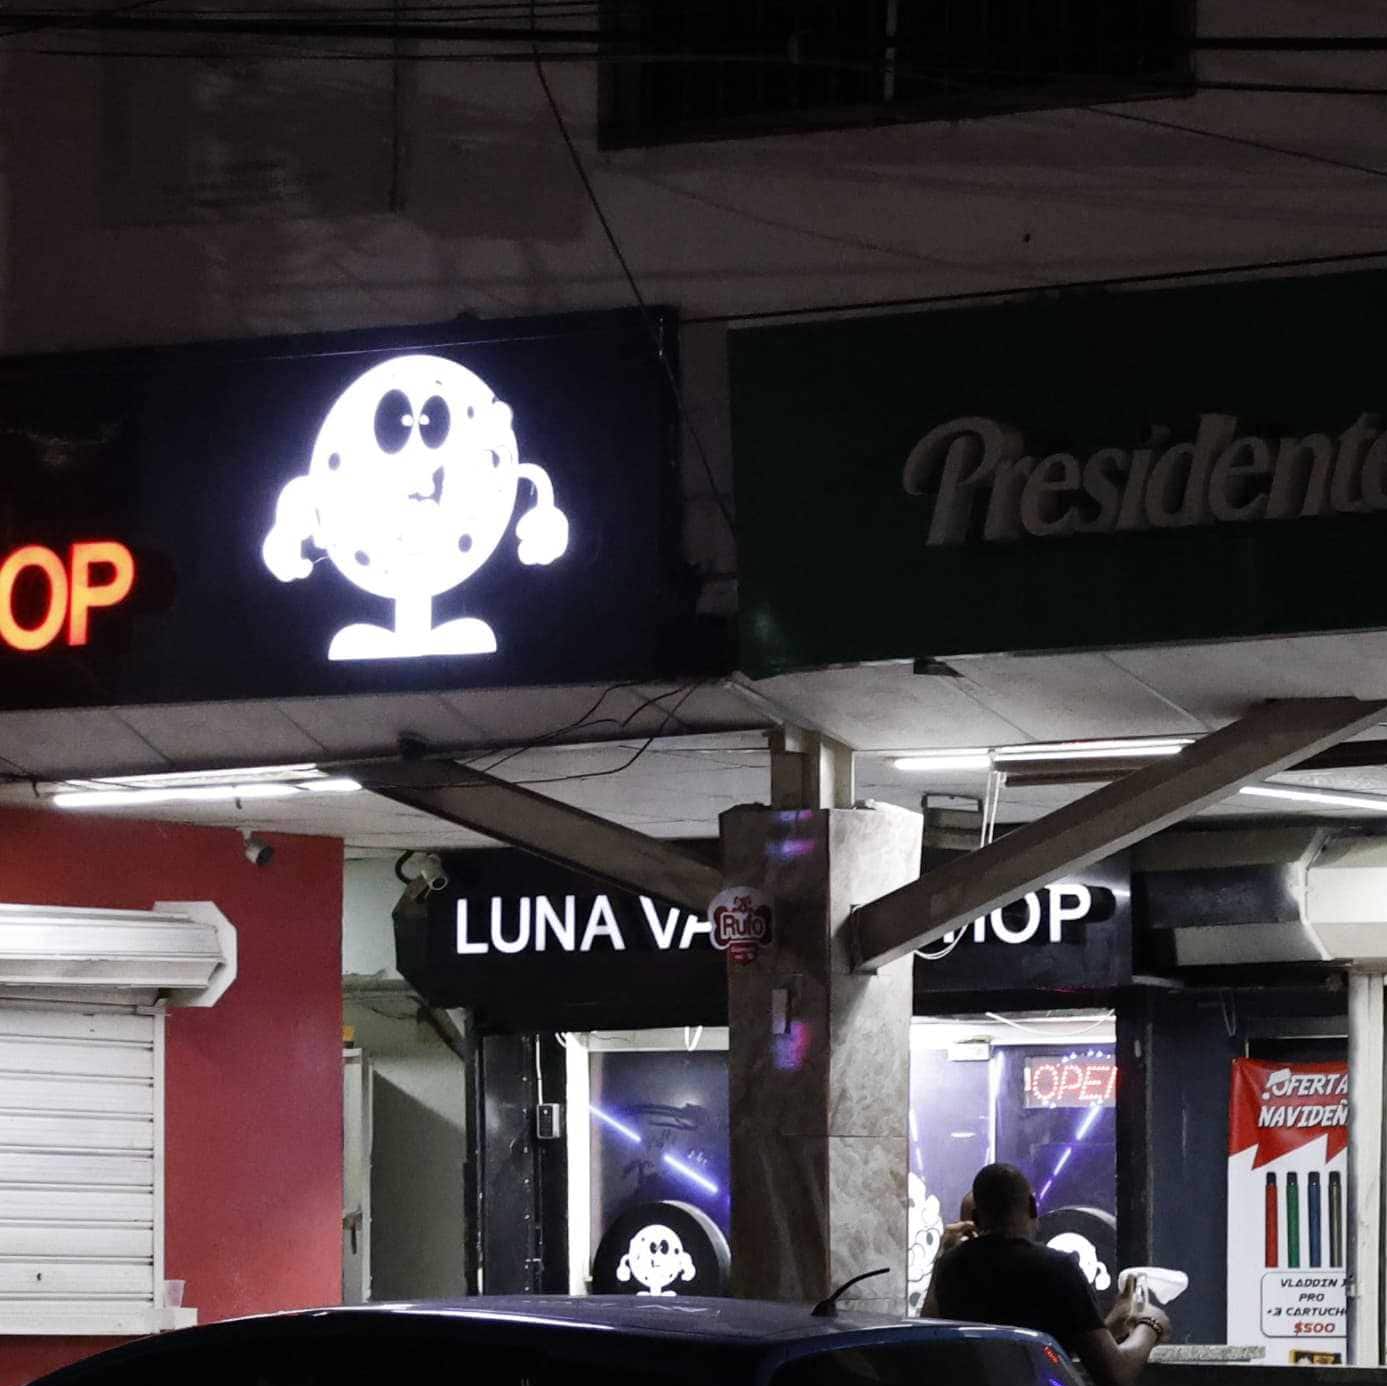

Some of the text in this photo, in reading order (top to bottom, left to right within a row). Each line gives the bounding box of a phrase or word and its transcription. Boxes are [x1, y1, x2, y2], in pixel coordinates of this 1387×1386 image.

[456, 894, 627, 955] LUNA
[1280, 1278, 1338, 1288] VLADDIN
[1298, 1292, 1326, 1302] PRO
